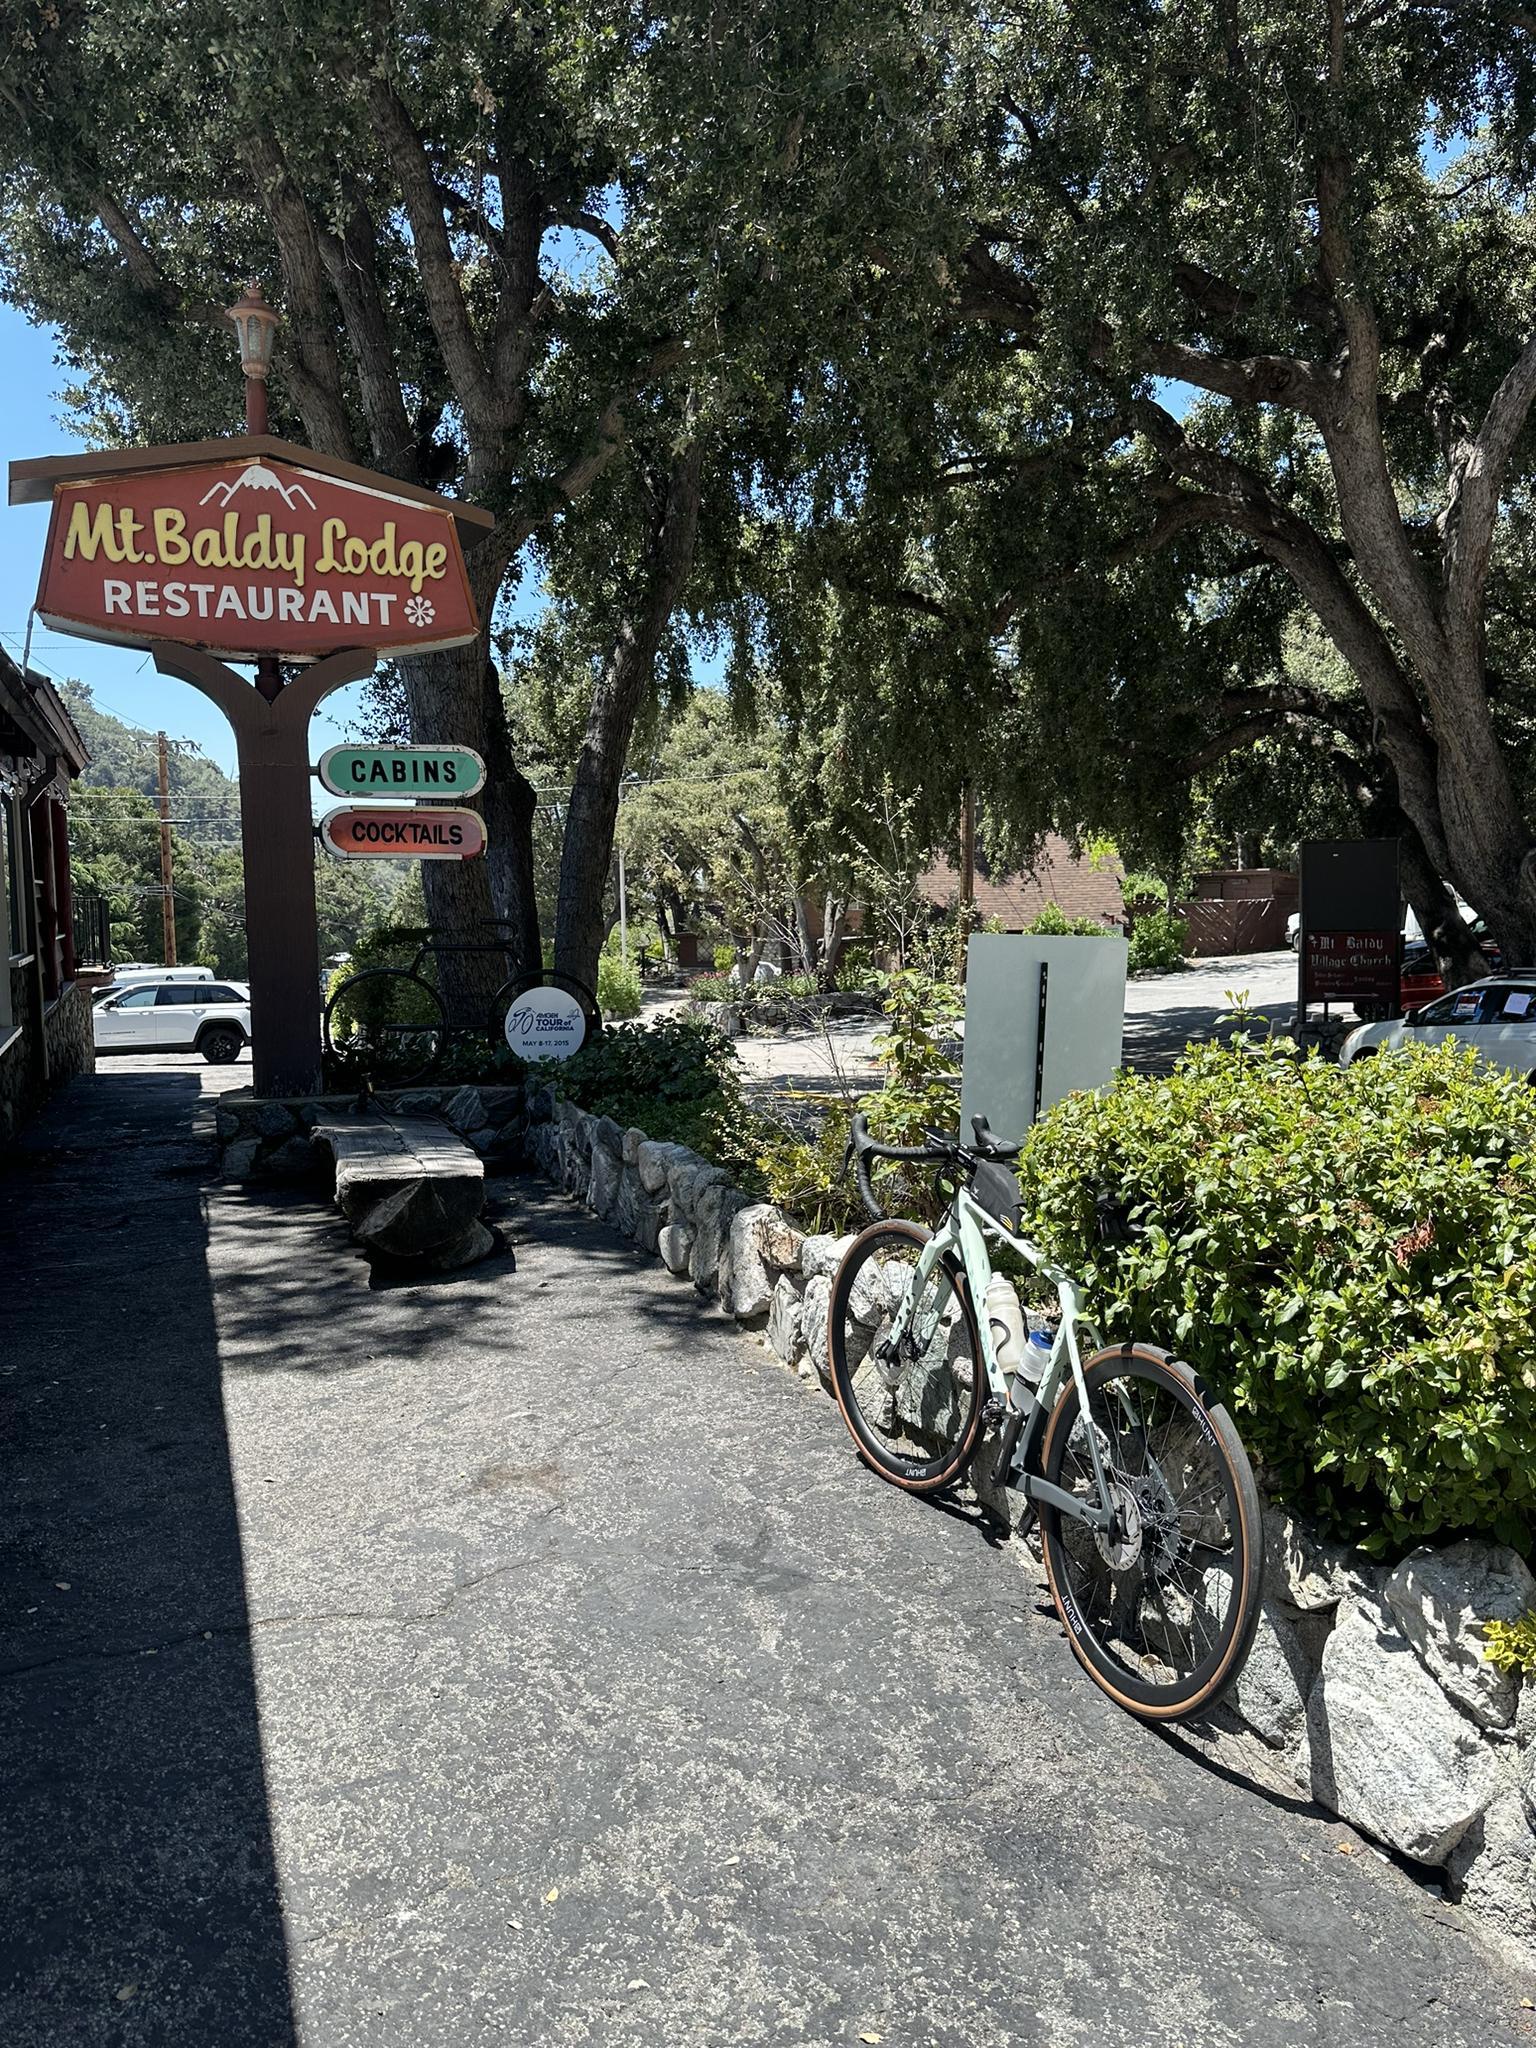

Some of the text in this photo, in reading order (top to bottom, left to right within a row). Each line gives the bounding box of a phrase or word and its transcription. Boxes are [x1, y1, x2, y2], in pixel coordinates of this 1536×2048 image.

[154, 507, 306, 586] Baldy
[315, 517, 447, 594] Lodge
[104, 579, 397, 626] RESTAURANT
[351, 760, 457, 783] CABINS
[352, 822, 463, 845] COCKTAILS
[1346, 936, 1384, 950] Baldy
[1311, 954, 1392, 968] Village Church
[1197, 1414, 1217, 1447] HUNT
[1061, 1595, 1078, 1626] HUNT
